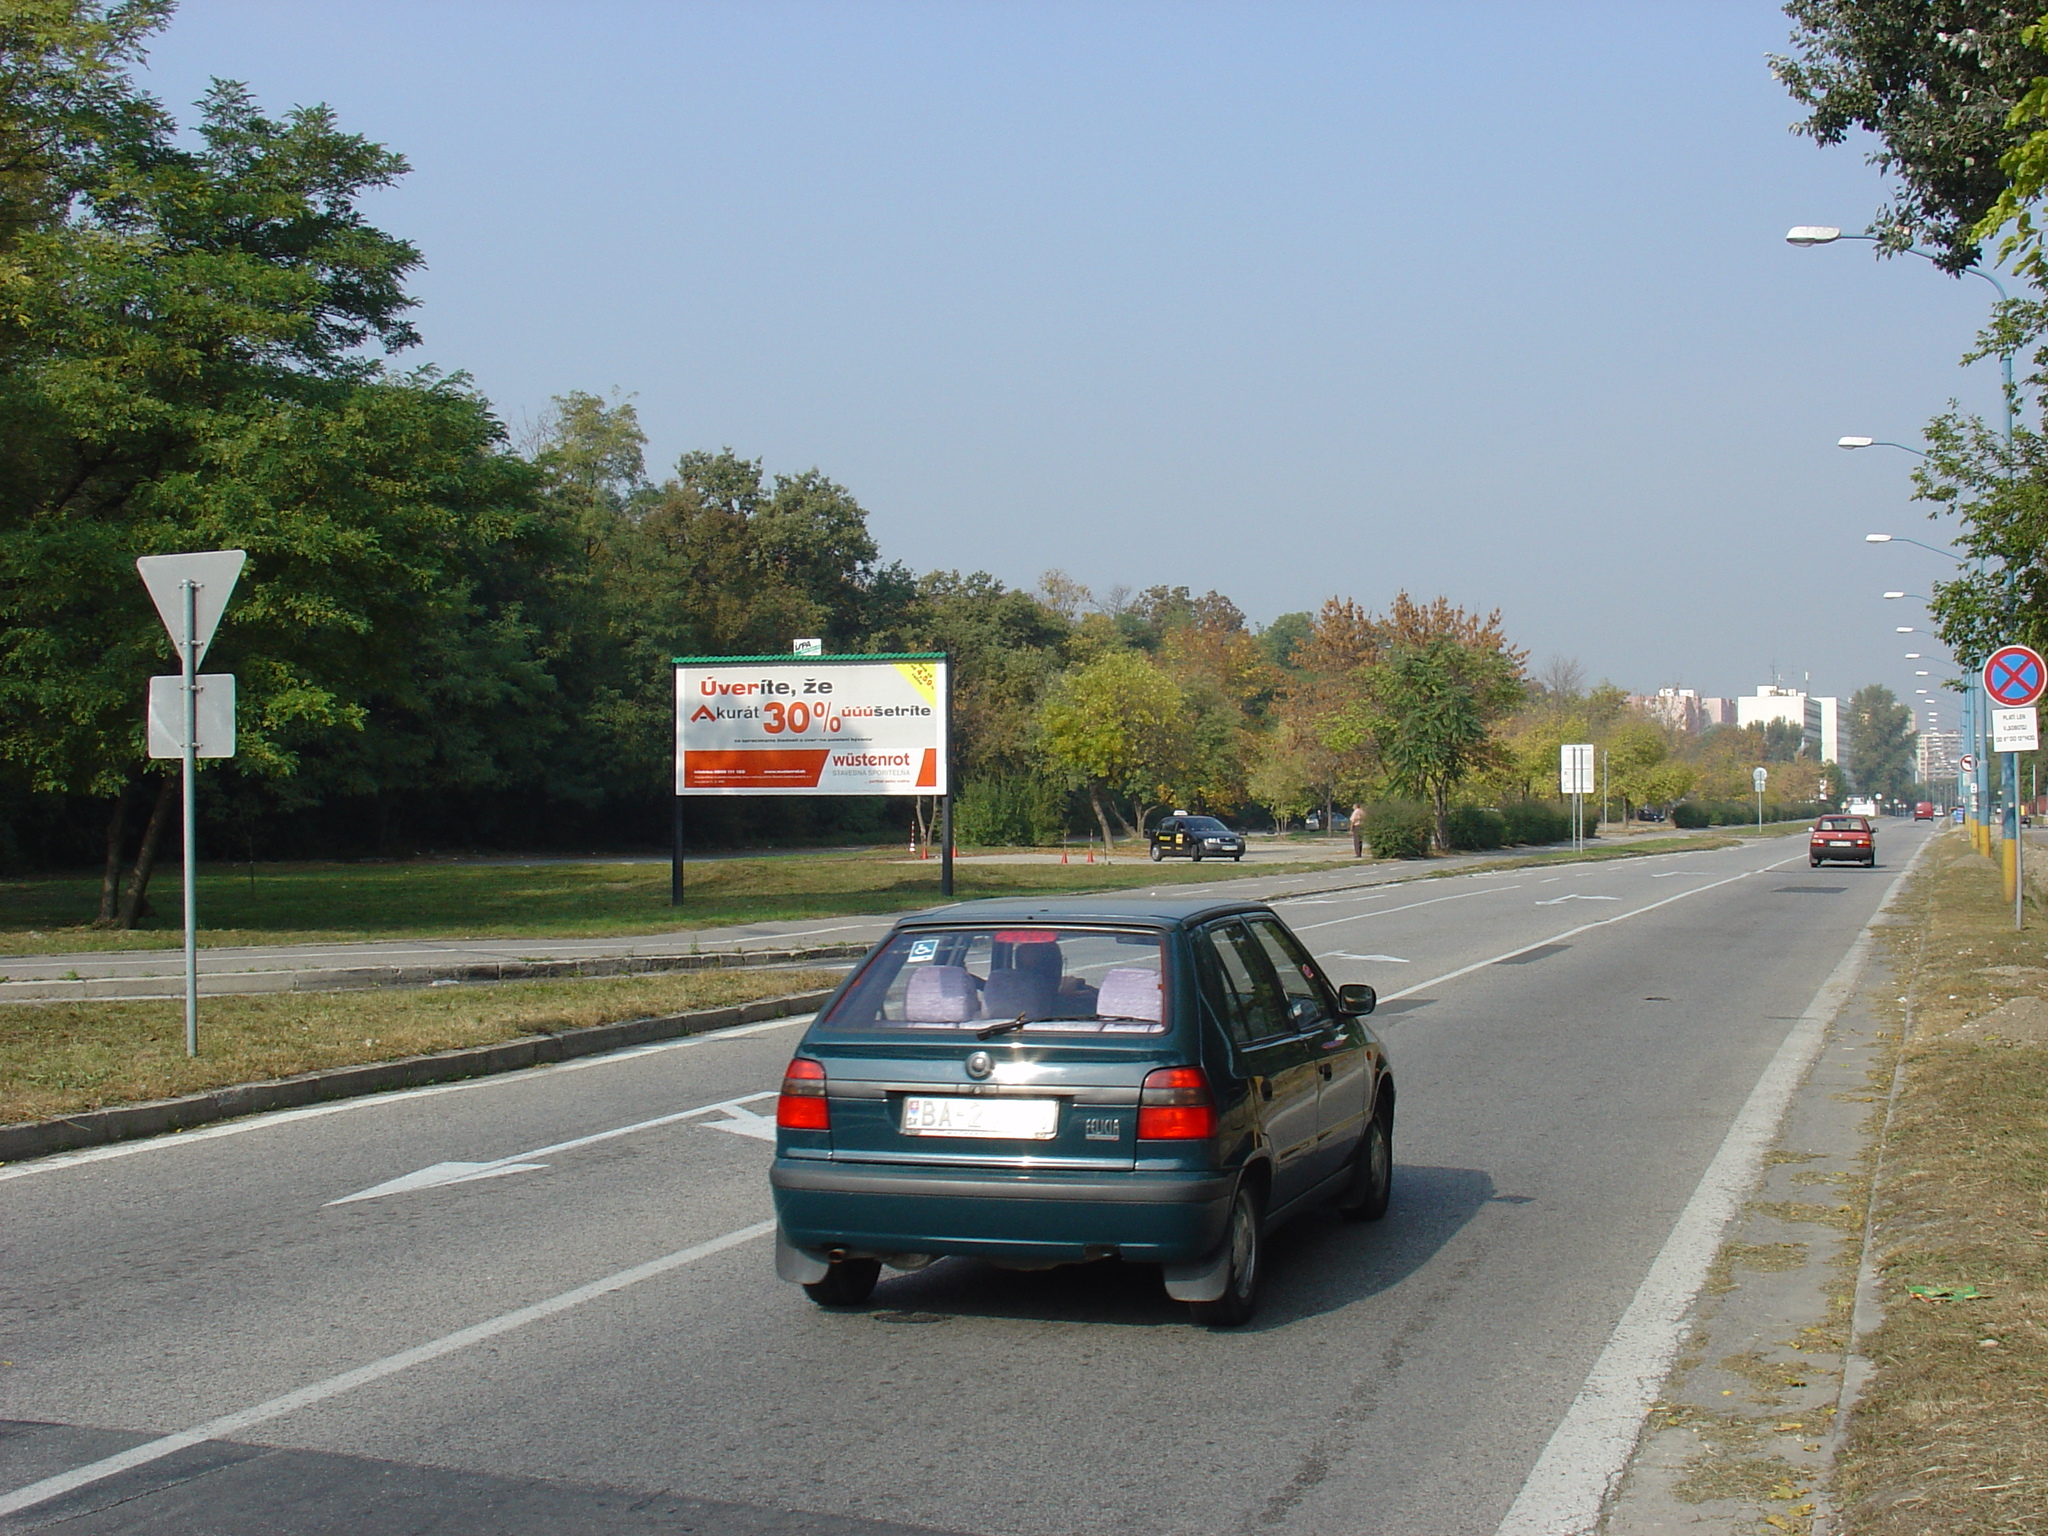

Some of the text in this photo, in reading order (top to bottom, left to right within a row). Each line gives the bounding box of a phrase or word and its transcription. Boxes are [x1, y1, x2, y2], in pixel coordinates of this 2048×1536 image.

[802, 678, 833, 695] že
[690, 704, 760, 723] Akurát
[763, 701, 841, 735] 30%
[832, 752, 910, 766] wüstenrot
[1086, 1119, 1119, 1135] FELICIA
